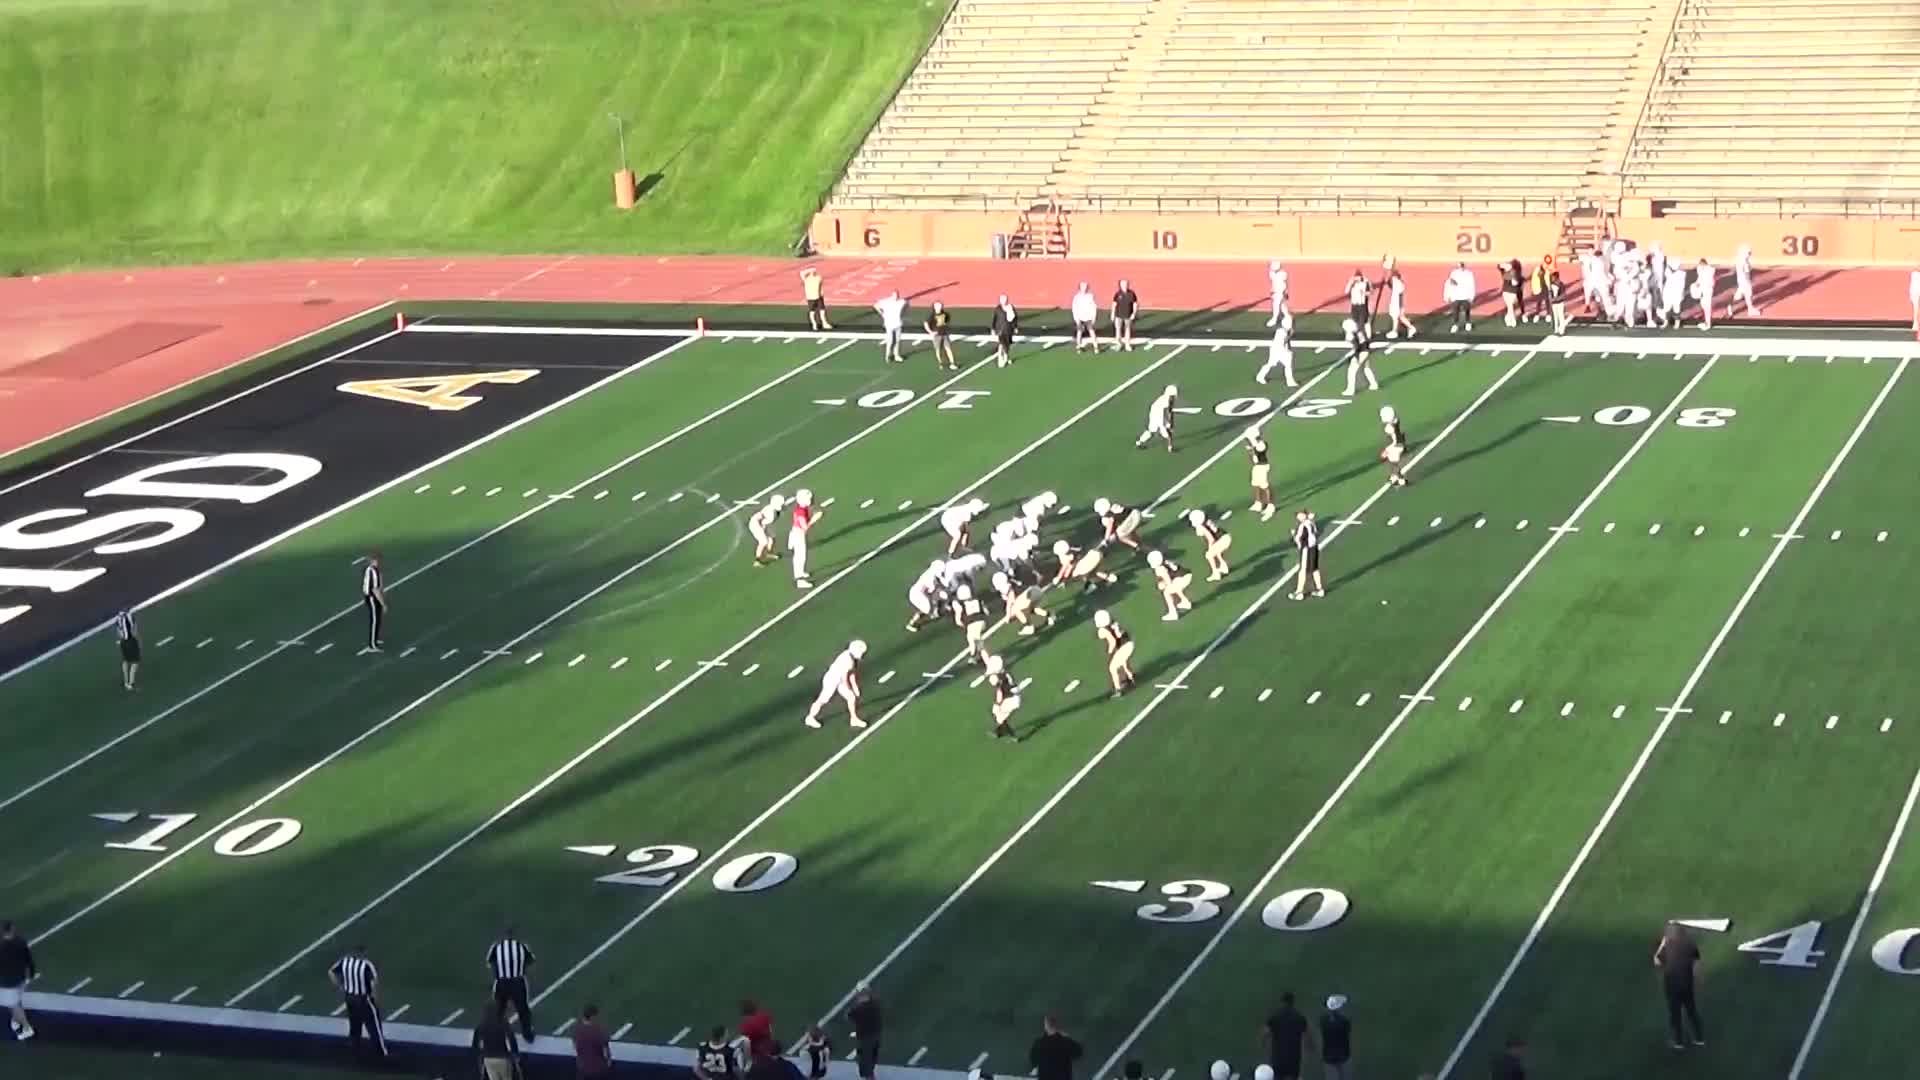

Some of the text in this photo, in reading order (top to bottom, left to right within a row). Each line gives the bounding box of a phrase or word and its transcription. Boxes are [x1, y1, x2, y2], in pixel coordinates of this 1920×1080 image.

[863, 229, 880, 248] G
[1152, 231, 1178, 249] 10
[1456, 233, 1492, 253] 20
[1781, 236, 1820, 256] 30
[337, 368, 541, 411] A
[104, 812, 302, 857] 10
[596, 844, 799, 893] 20
[1136, 879, 1350, 932] 30
